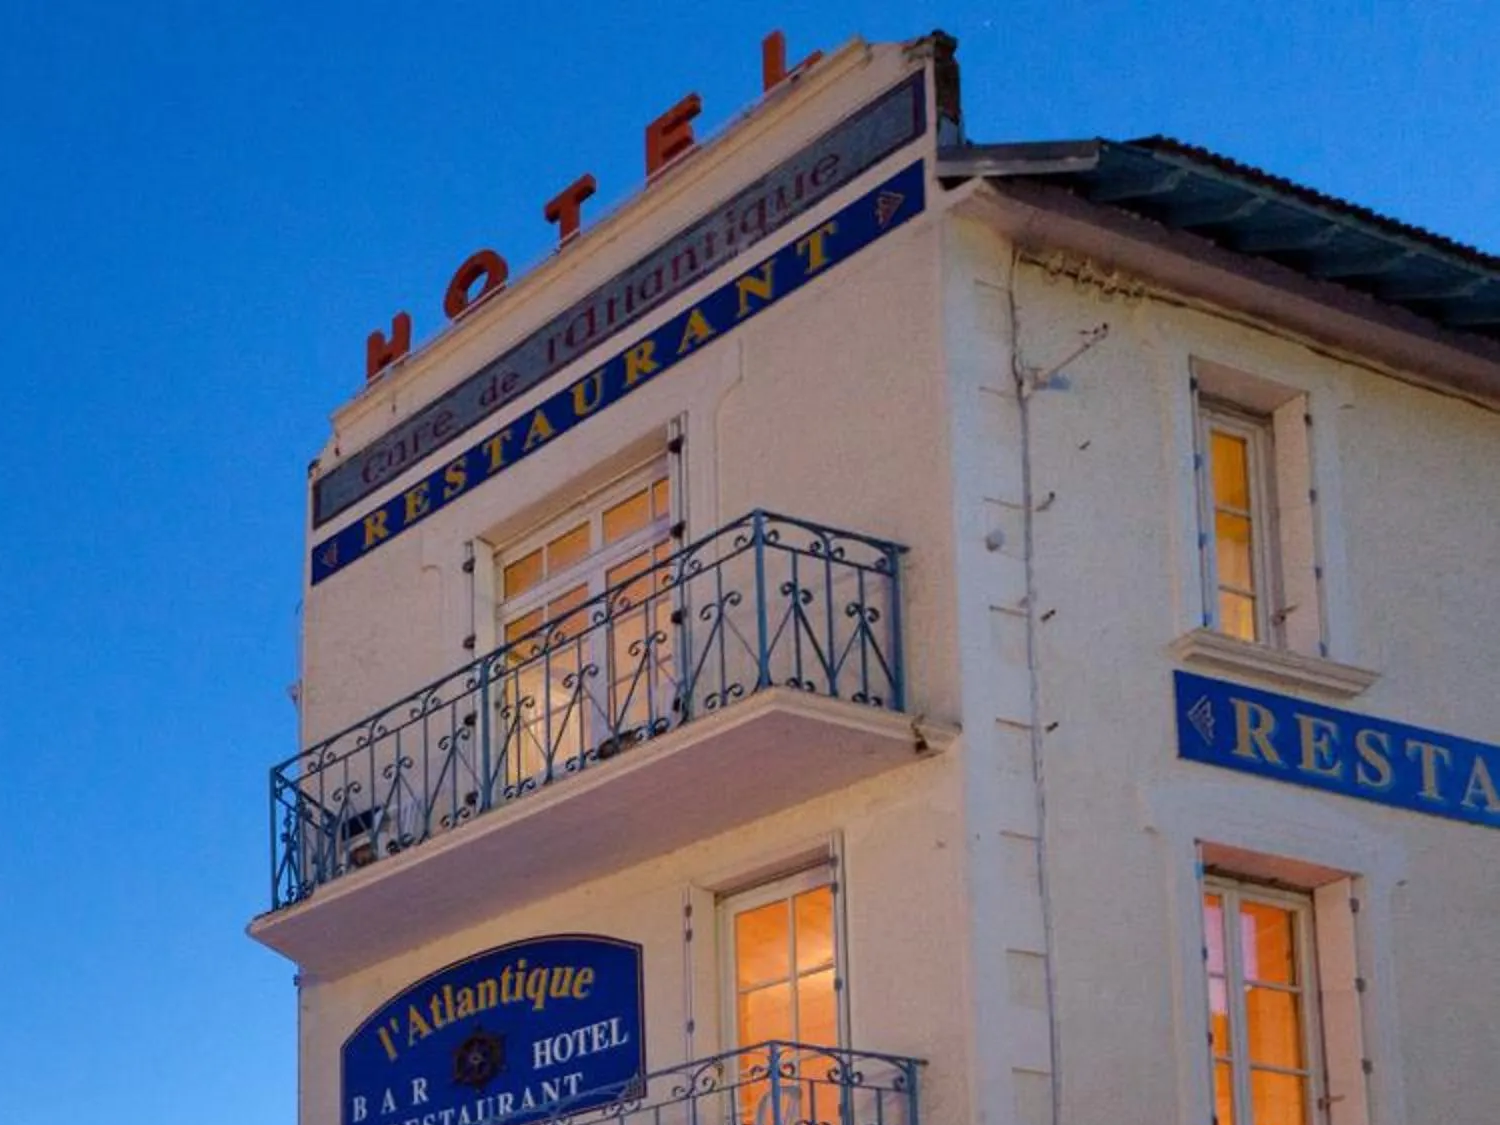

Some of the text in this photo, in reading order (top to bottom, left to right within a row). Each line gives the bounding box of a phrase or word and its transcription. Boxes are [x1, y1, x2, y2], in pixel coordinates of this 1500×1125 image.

[366, 30, 823, 382] HOTEL
[362, 221, 839, 552] RESTAURANT
[478, 370, 521, 407] de
[1229, 697, 1500, 813] RESTA
[377, 958, 595, 1061] l'Atlantique
[532, 1017, 628, 1070] HOTEL
[351, 1077, 430, 1124] BAR
